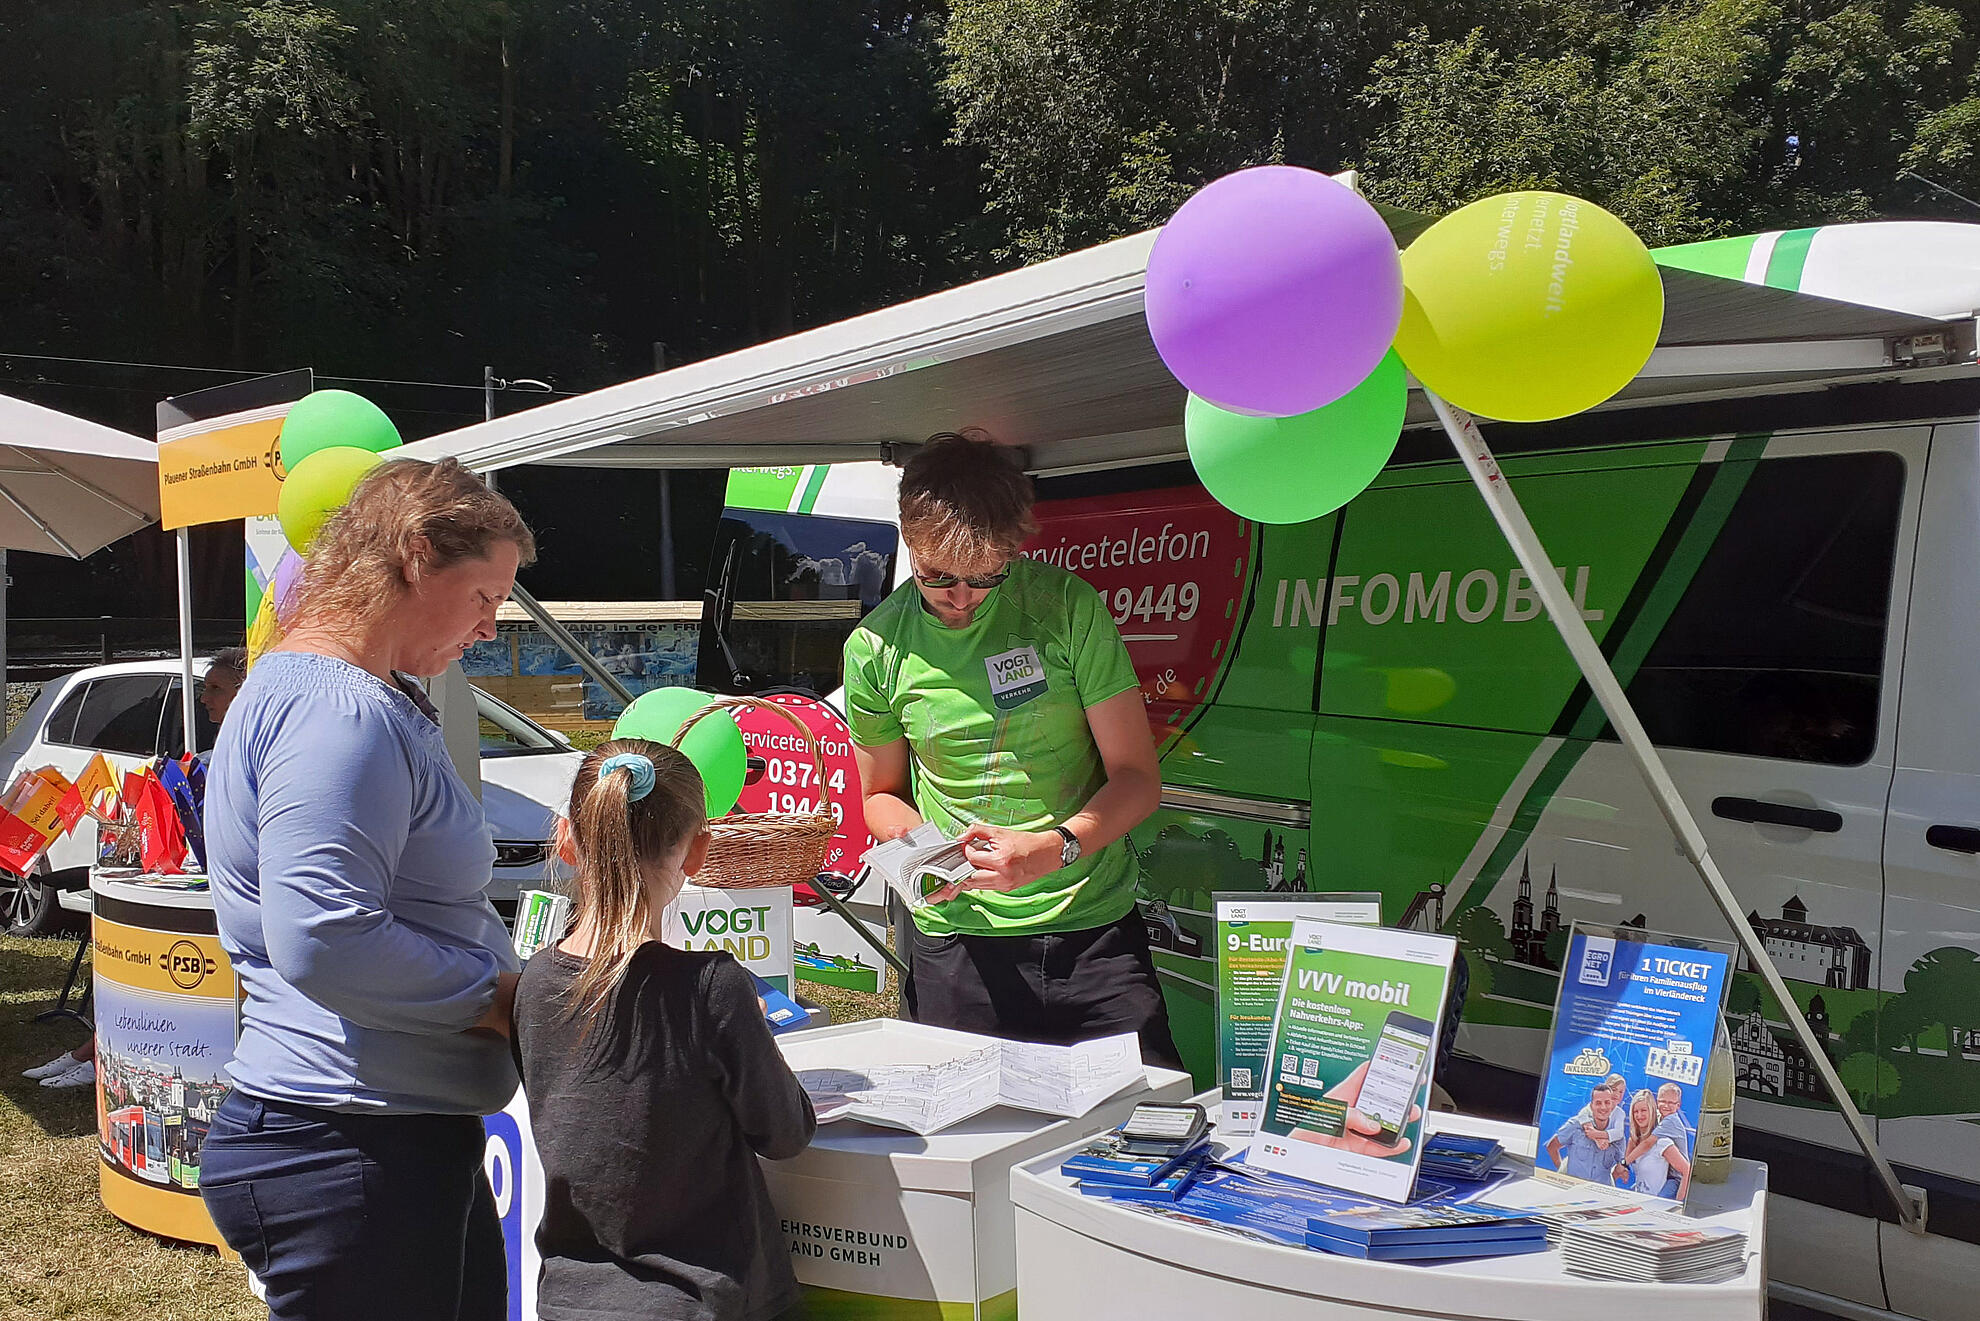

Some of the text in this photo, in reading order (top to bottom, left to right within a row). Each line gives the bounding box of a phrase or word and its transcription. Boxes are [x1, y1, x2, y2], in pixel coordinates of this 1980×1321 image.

[164, 472, 188, 486] Plauener
[189, 460, 232, 480] Straßenbahn
[233, 456, 258, 471] GmbH
[1018, 523, 1210, 571] rvicetelefon
[497, 623, 539, 632] ZZLE
[613, 623, 624, 632] in
[636, 623, 667, 632] der
[993, 654, 1030, 673] VOGT
[997, 665, 1034, 685] LAND
[1001, 687, 1032, 700] VERKEHR
[742, 729, 848, 757] ervicetelfon
[680, 906, 771, 937] VOGT
[125, 949, 151, 966] GmbH
[173, 956, 201, 973] PSB
[1584, 960, 1602, 968] NET
[1586, 951, 1609, 961] EGRO
[1641, 958, 1712, 979] 1 TICKET
[1298, 968, 1344, 994] VVV
[1345, 979, 1410, 1006] mobil
[1619, 971, 1631, 980] für
[1650, 977, 1708, 993] Familienausflug
[1644, 986, 1706, 1003] im Vierländereck
[1292, 998, 1352, 1016] Die kostenlose
[114, 1008, 177, 1032] Lebenslinien
[1289, 1009, 1365, 1031] Nahverkehrs-App:
[127, 1039, 212, 1058] unserer Stadt.
[1565, 1064, 1601, 1075] INKLUSIVE
[781, 1219, 908, 1249] EHRSVERBUND
[790, 1240, 881, 1266] AND GMBH
